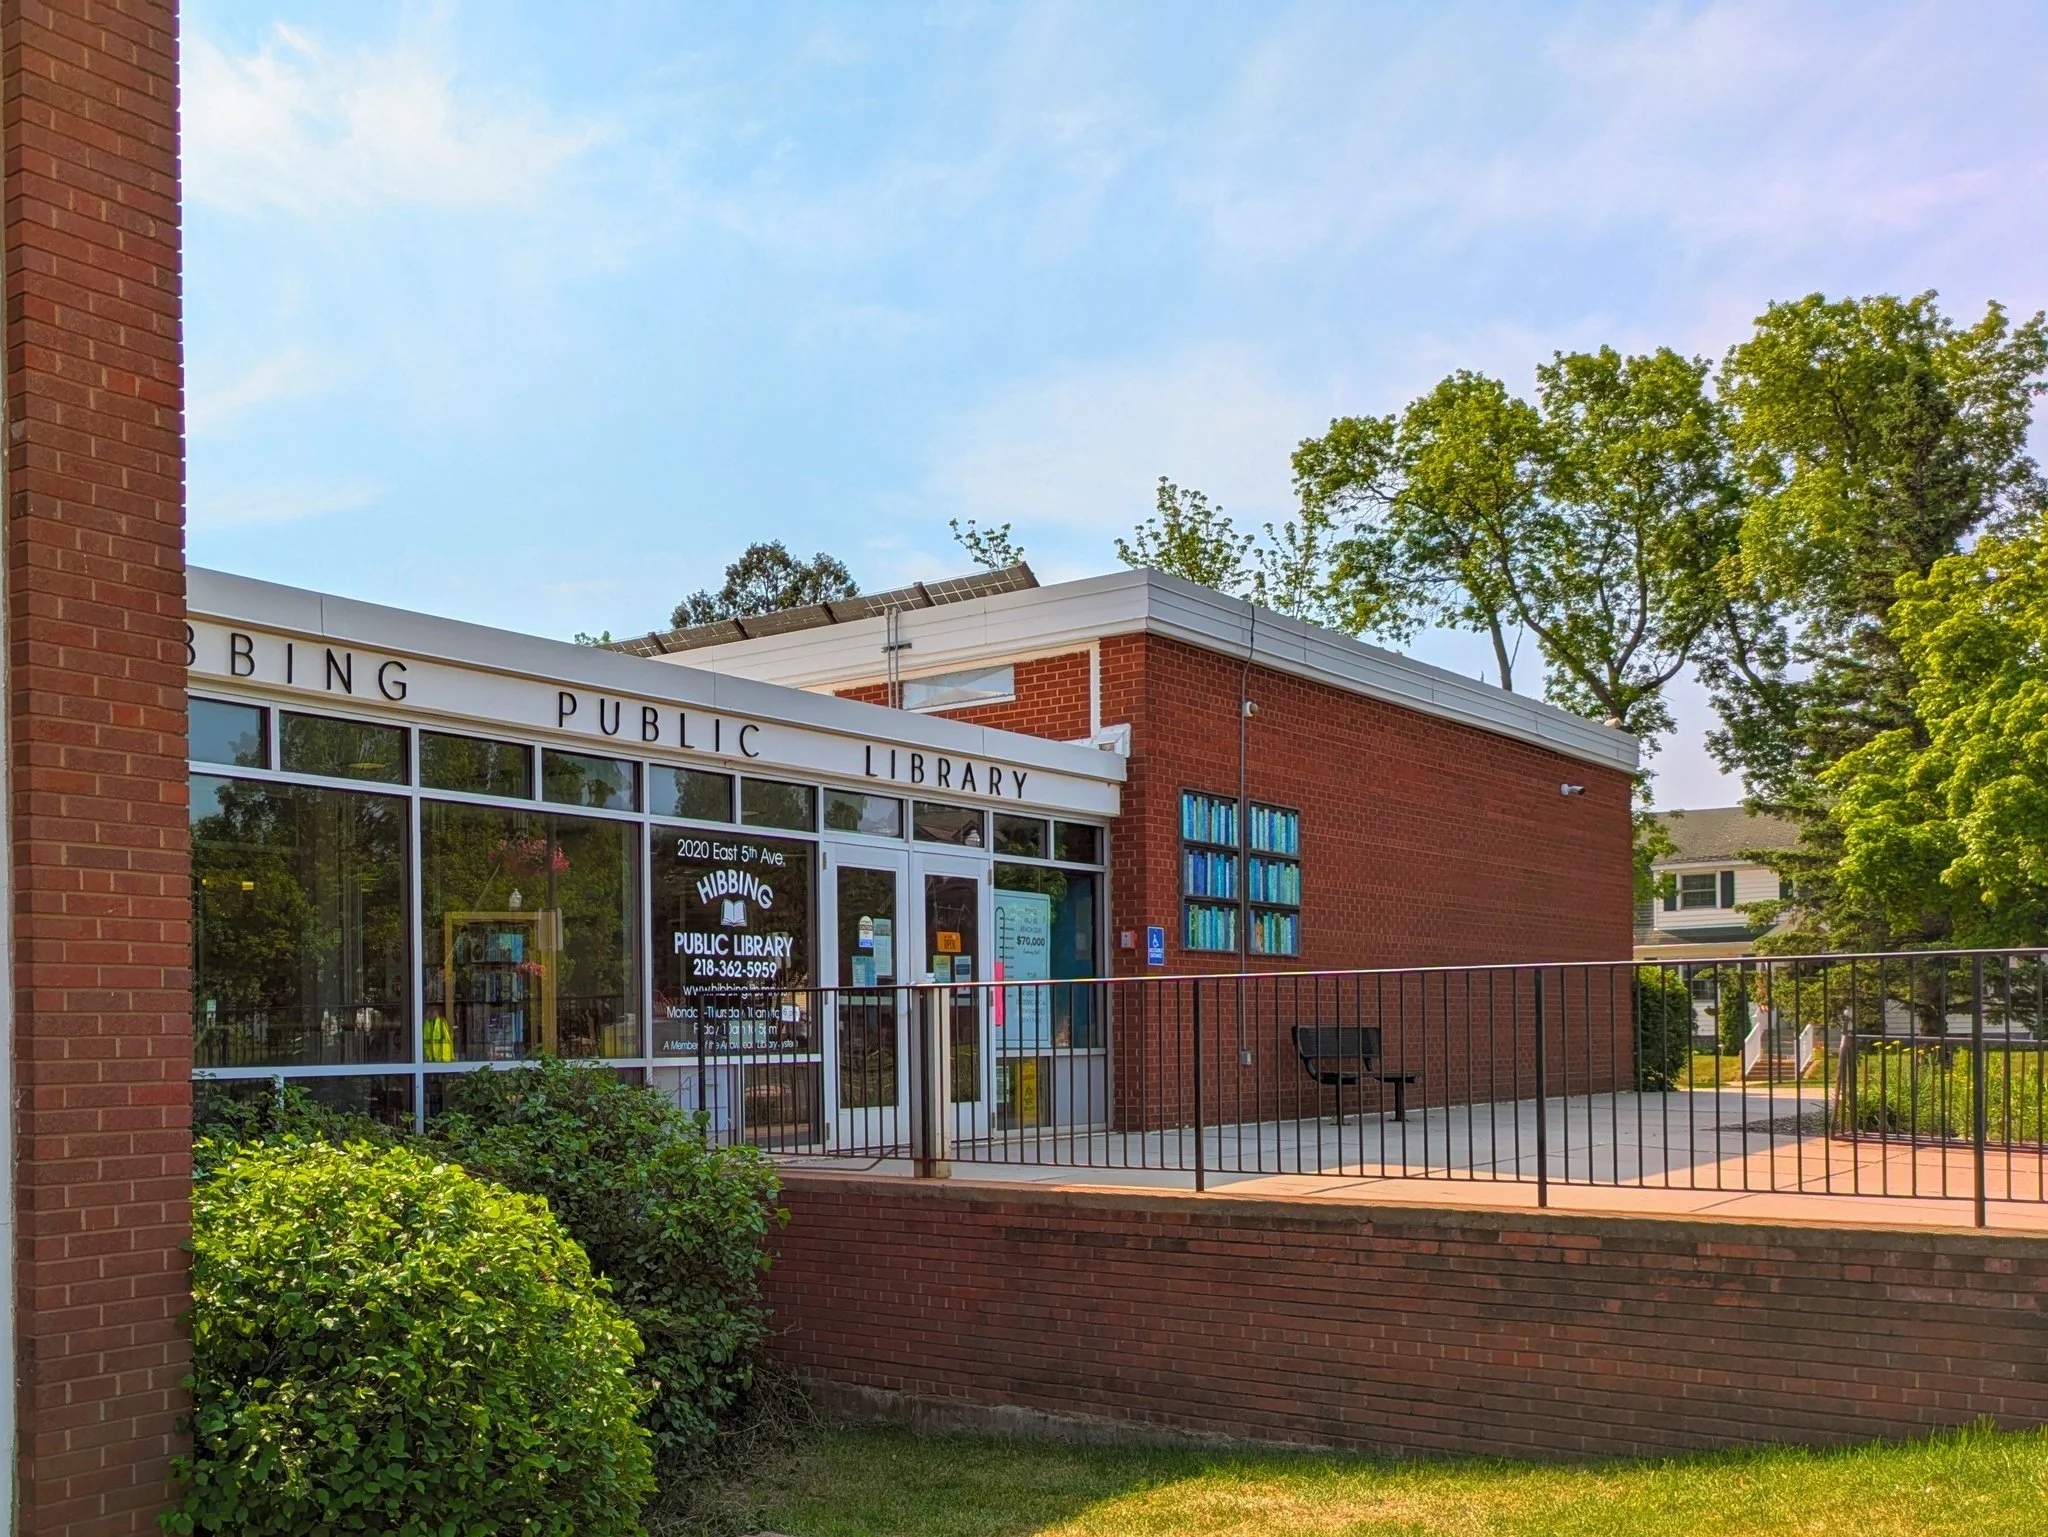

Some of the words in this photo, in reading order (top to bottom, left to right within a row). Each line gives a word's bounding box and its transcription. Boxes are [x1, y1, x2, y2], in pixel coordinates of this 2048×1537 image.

[558, 691, 760, 758] PUBLIC
[865, 745, 1028, 799] LIBRARY
[677, 838, 709, 858] 2020
[713, 842, 738, 861] East
[741, 846, 758, 863] 5th
[760, 848, 786, 867] Ave.
[696, 869, 774, 910] HIBBING
[674, 931, 729, 956] PUBLIC
[733, 934, 793, 957] LIBRARY
[1016, 935, 1046, 947] $70,000
[693, 959, 777, 978] 218-362-5959
[693, 1022, 719, 1036] Fday
[663, 1040, 670, 1051] A
[757, 1039, 778, 1050] Libary
